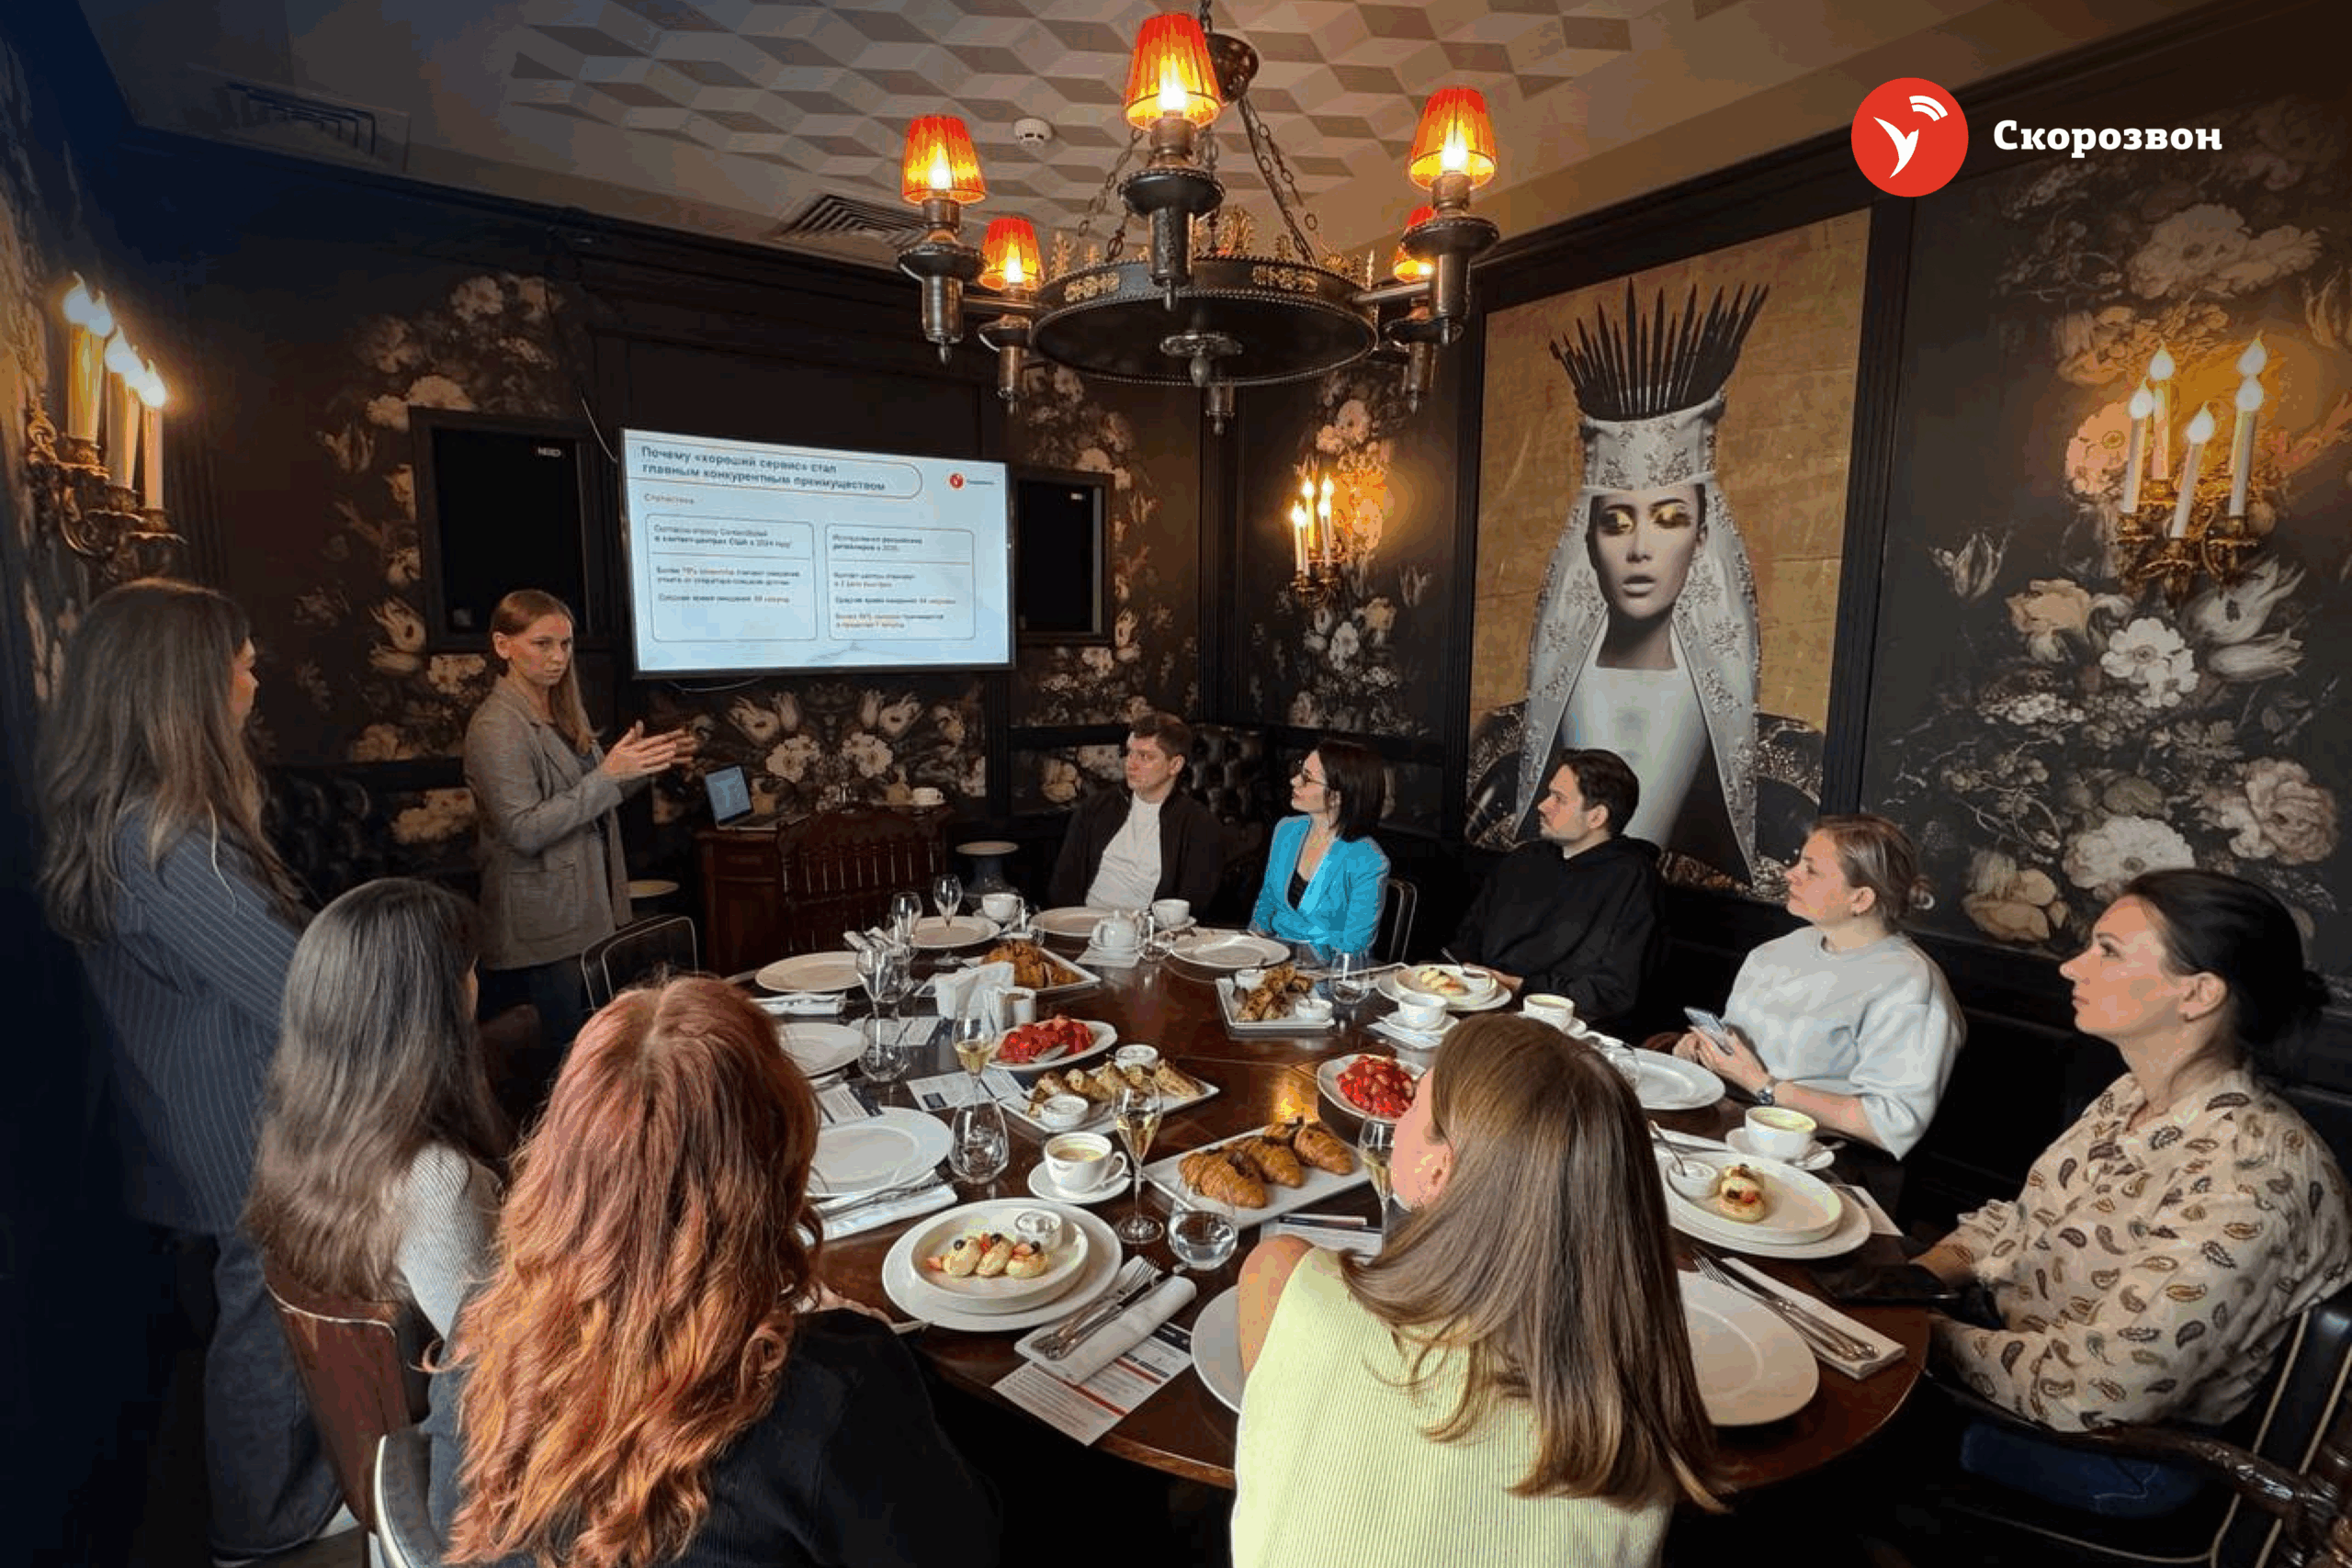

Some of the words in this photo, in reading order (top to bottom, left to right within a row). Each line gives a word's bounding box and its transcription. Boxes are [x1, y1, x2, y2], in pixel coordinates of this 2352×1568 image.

[641, 446, 692, 465] Почему
[695, 455, 756, 467] «хороший
[811, 463, 837, 473] стал
[642, 464, 699, 477] главным
[704, 468, 791, 483] конкурентным
[793, 477, 885, 491] преимуществом
